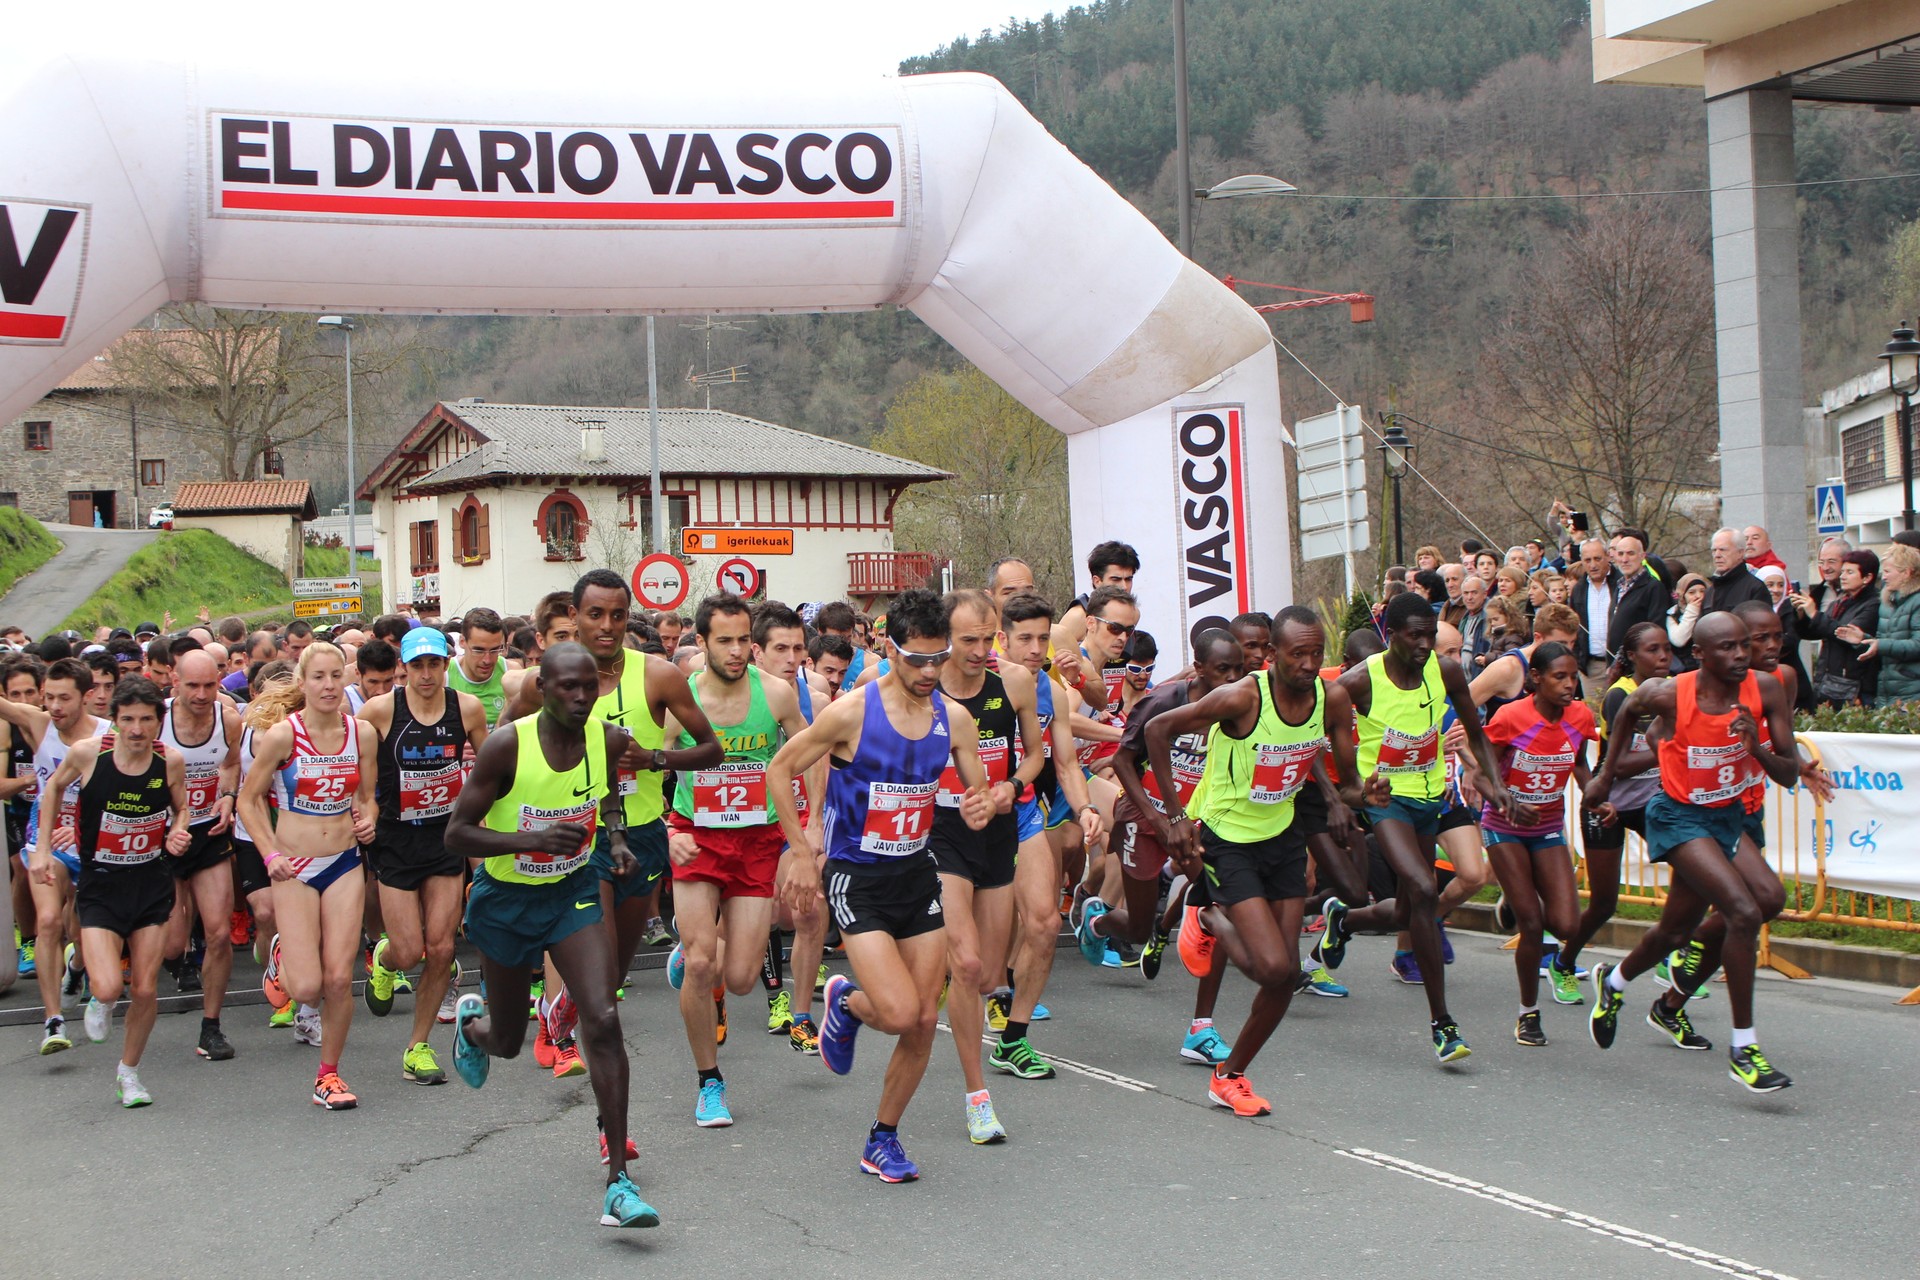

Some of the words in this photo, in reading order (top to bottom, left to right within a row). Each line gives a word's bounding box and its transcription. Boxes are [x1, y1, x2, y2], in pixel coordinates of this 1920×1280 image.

[221, 118, 318, 186] EL
[333, 125, 618, 195] DIARIO
[629, 132, 892, 195] VASCO
[1179, 413, 1233, 608] VASCO
[727, 536, 789, 547] igerilekuak
[1397, 731, 1421, 741] DIARIO
[1274, 744, 1300, 752] DIARIO
[1704, 747, 1732, 755] DIARIO
[1403, 750, 1419, 763] 3
[440, 762, 459, 775] VASCO
[737, 763, 763, 771] VASCO
[1281, 764, 1299, 784] 5
[1717, 765, 1735, 784] 8
[1525, 773, 1556, 789] 33
[314, 778, 345, 797] 25
[875, 784, 885, 792] EL
[887, 785, 918, 793] DIARIO
[119, 792, 141, 801] new
[419, 786, 448, 805] 32
[715, 786, 747, 806] 12
[1253, 791, 1281, 800] JUSTUS
[1695, 789, 1731, 801] STEPHEN
[107, 800, 150, 812] balance
[297, 800, 320, 810] ELENA
[523, 806, 534, 815] EL
[535, 809, 569, 817] DIARIO
[571, 799, 596, 814] VASCO
[143, 813, 165, 822] VASCO
[721, 813, 740, 822] IVAN
[891, 810, 921, 834] 11
[118, 834, 149, 850] 10
[873, 841, 894, 852] JAVI
[1123, 822, 1138, 867] FILA
[102, 853, 124, 861] ASIER
[126, 852, 154, 862] CUEVAS
[520, 862, 553, 873] MOSES
[555, 852, 588, 872] KURONG
